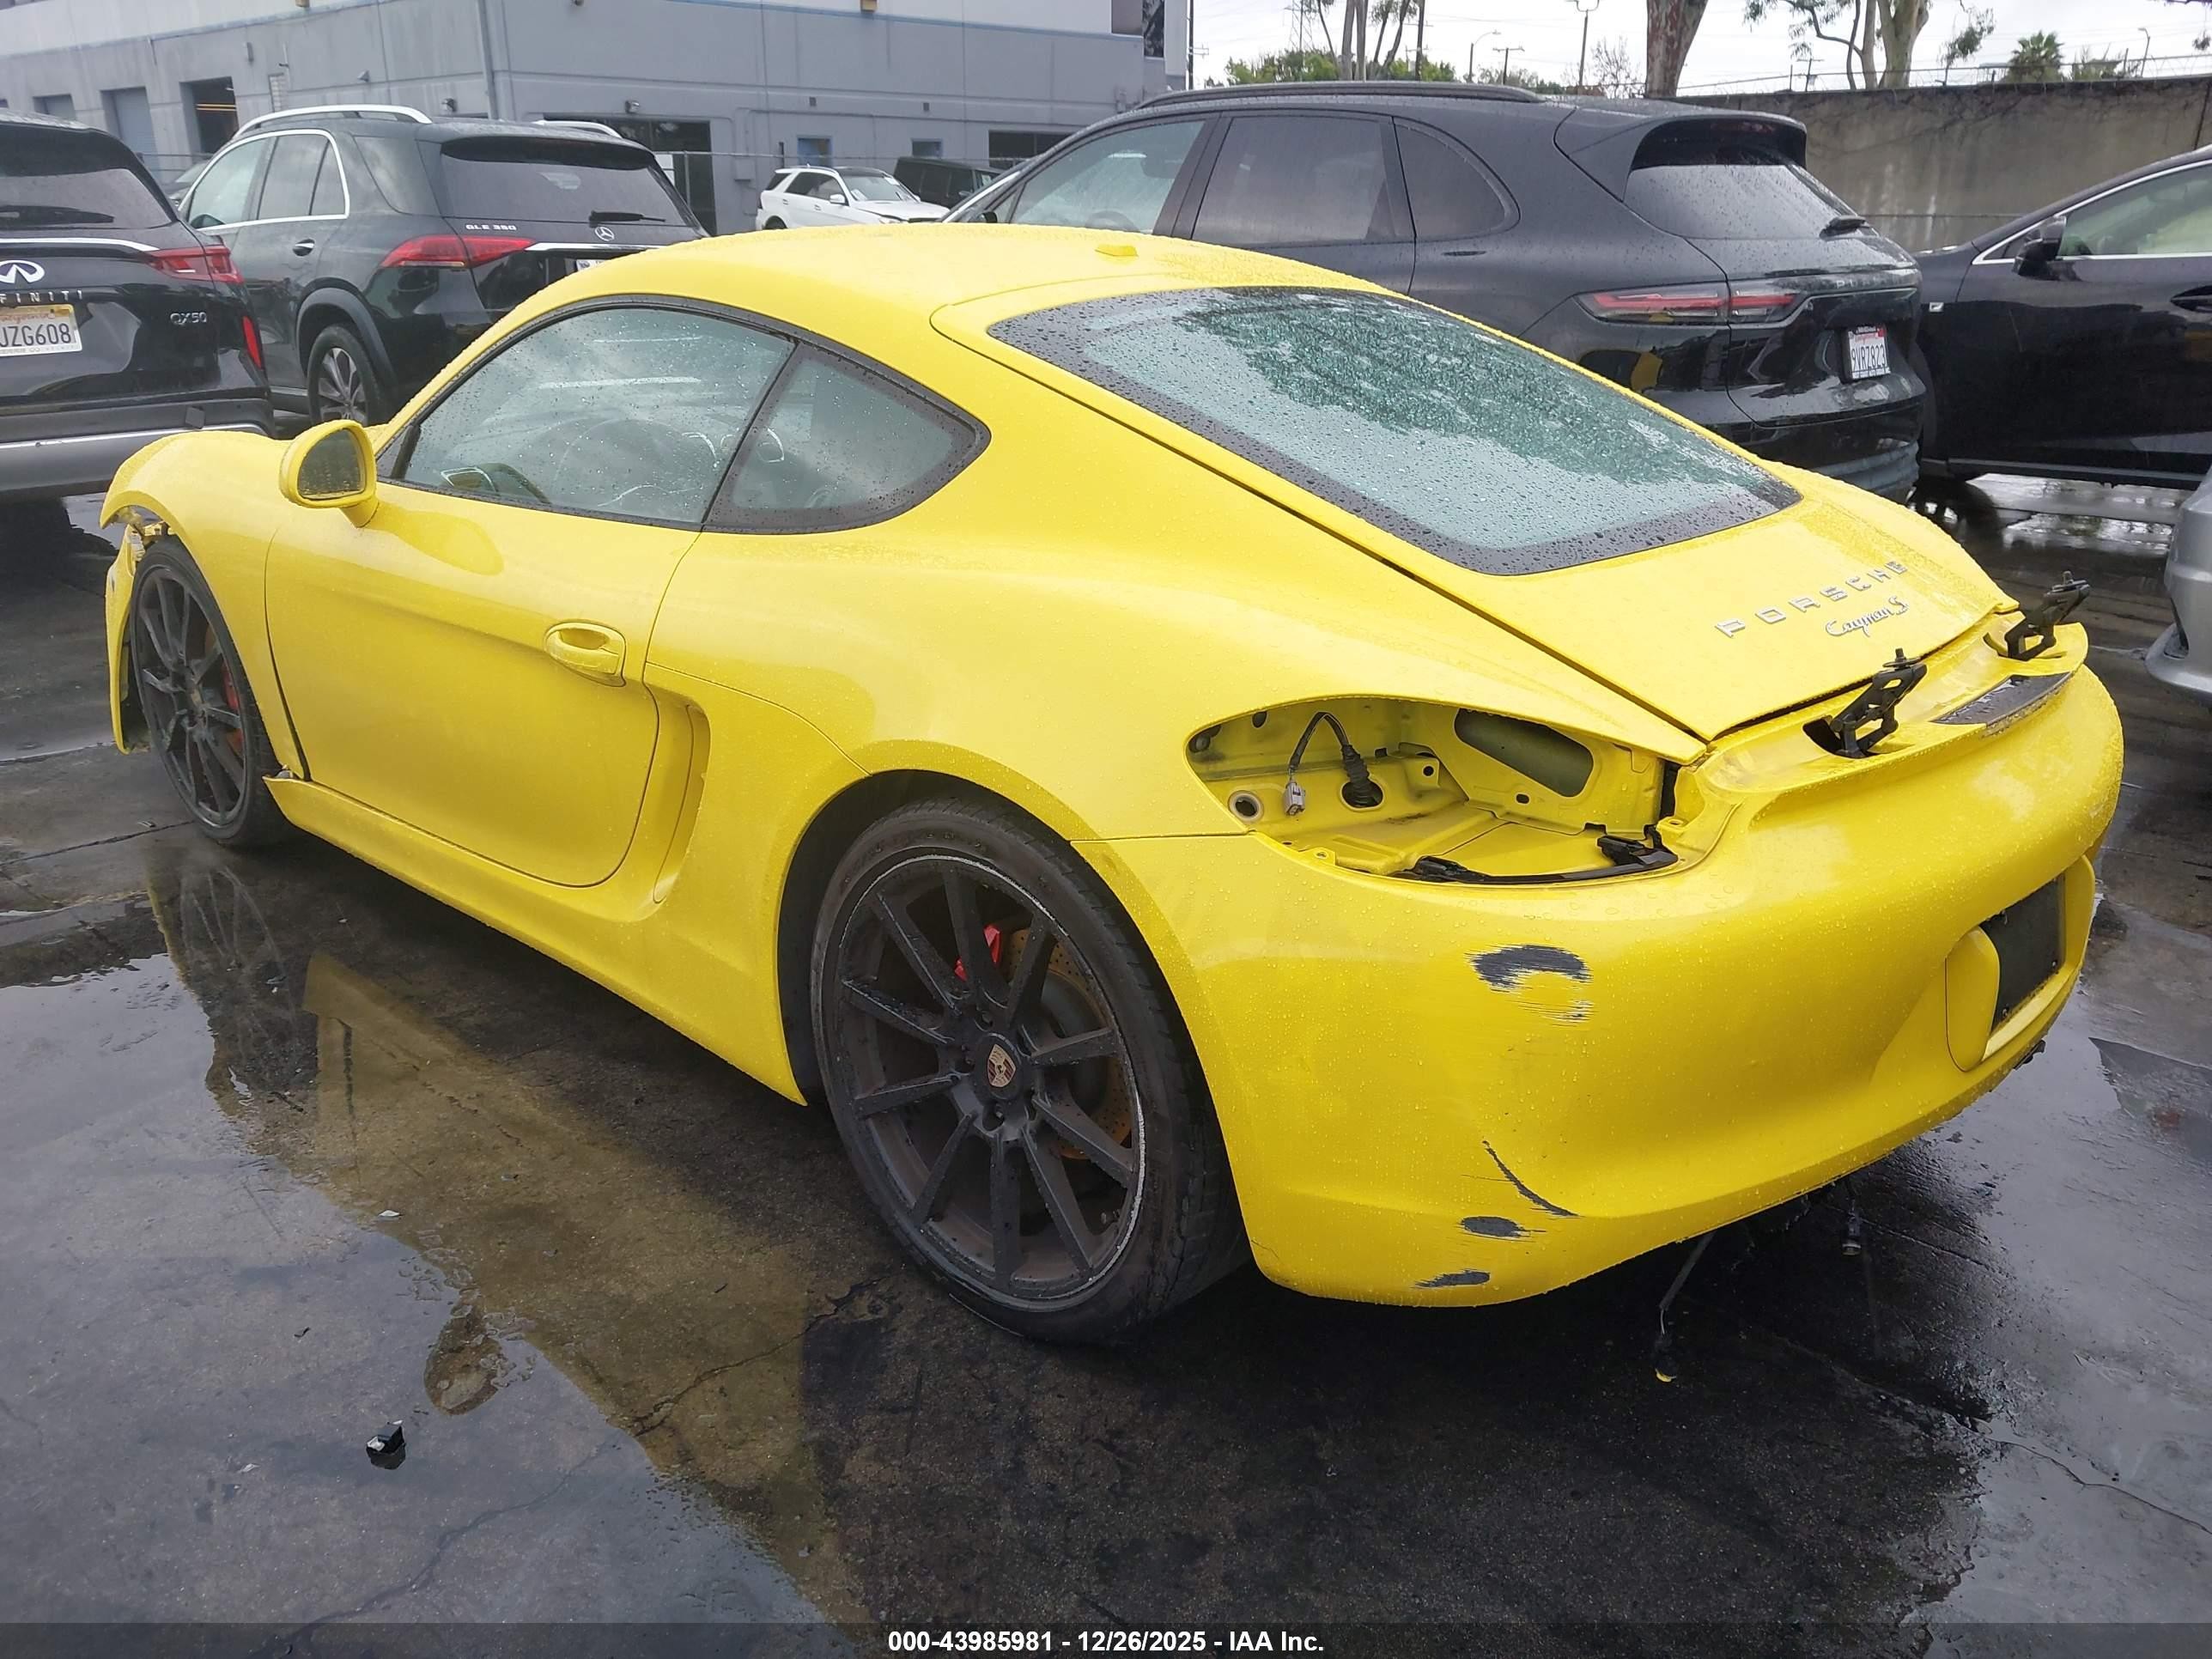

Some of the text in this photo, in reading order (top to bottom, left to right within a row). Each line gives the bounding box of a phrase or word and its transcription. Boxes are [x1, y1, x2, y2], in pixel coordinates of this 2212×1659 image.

[170, 312, 207, 325] QX50
[1850, 344, 1887, 372] 9VRZ823
[1714, 561, 1908, 638] PORSCHE
[1825, 595, 1909, 637] Cayman S
